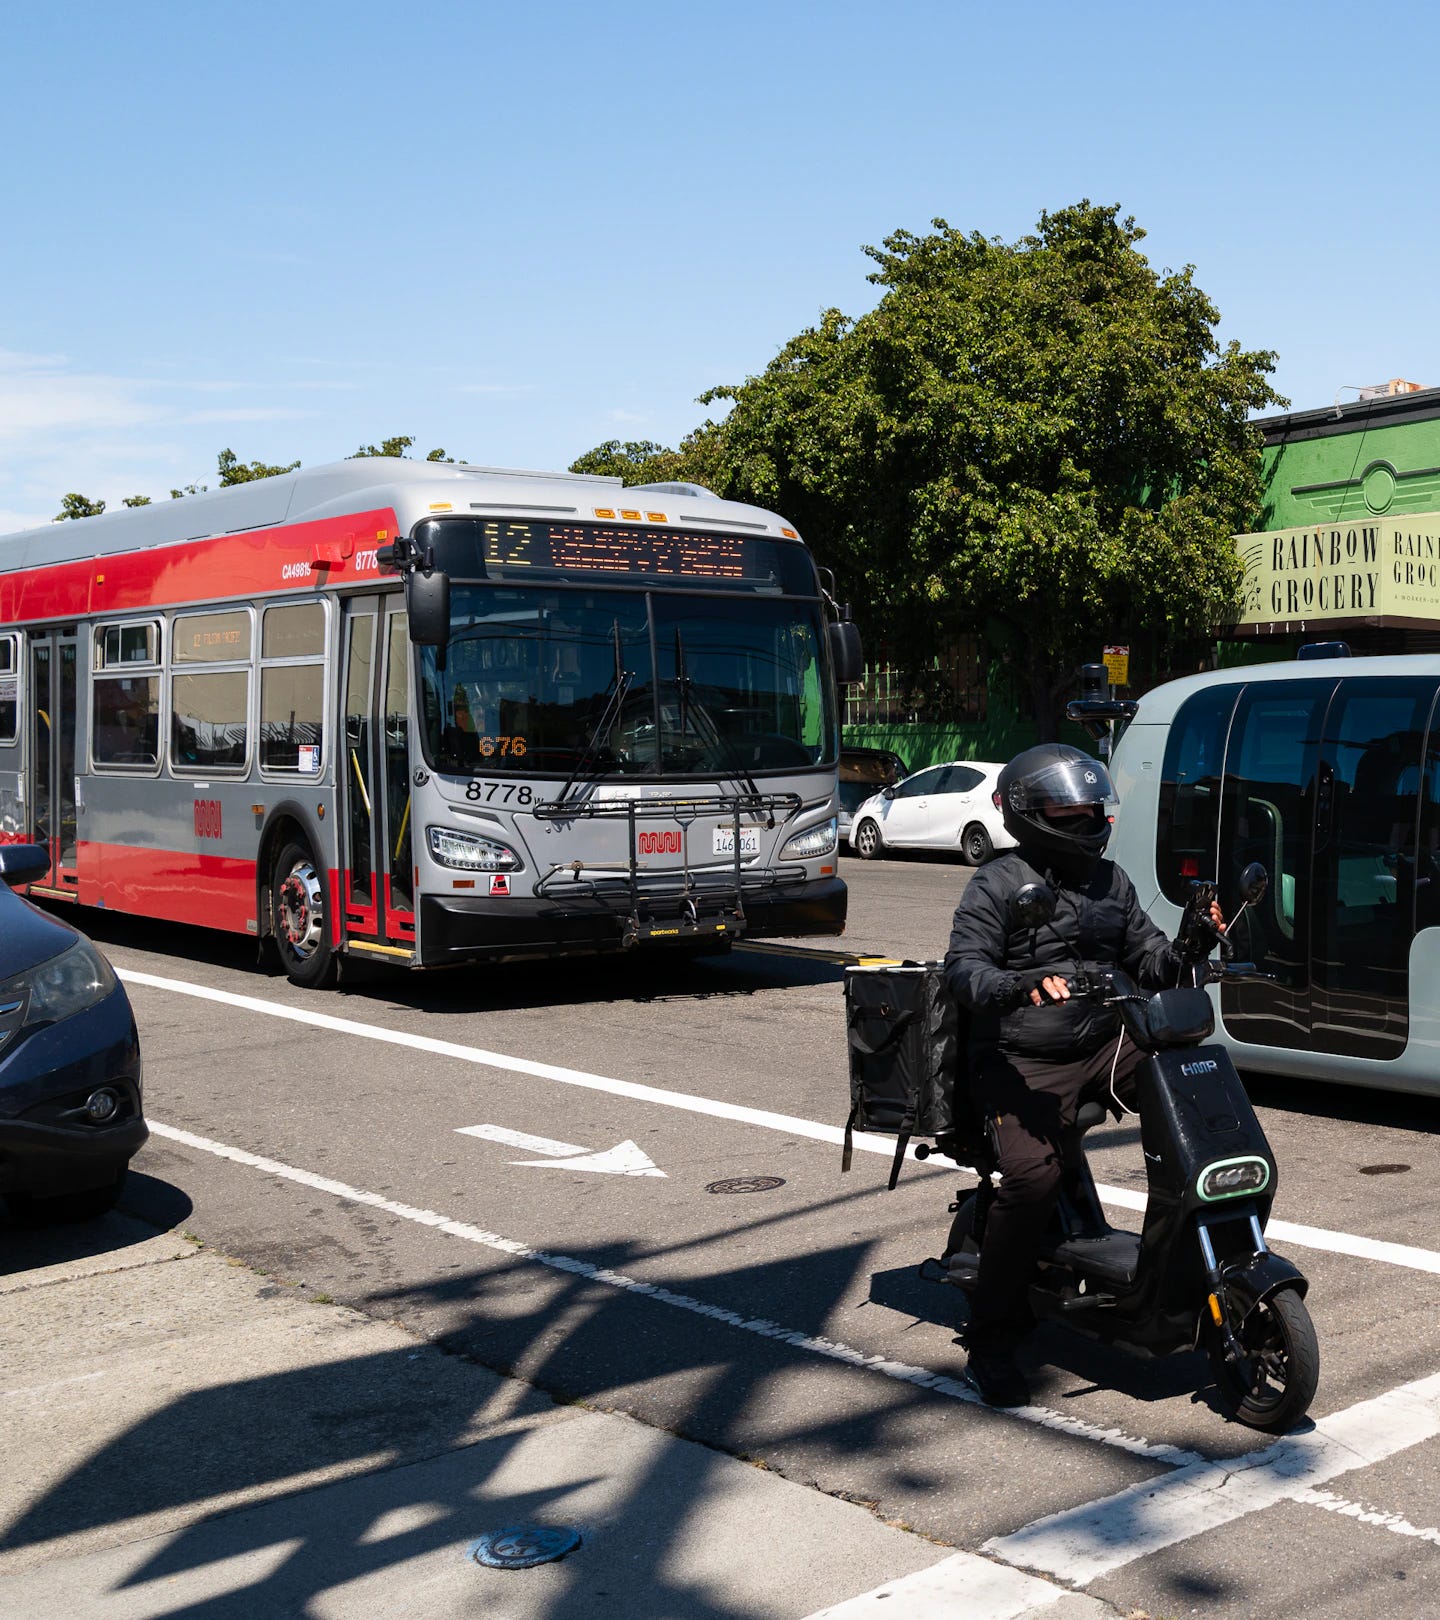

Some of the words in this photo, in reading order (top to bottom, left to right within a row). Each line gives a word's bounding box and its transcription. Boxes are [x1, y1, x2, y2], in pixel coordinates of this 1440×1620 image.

[484, 523, 532, 565] 12
[1272, 527, 1381, 571] RAINBOW
[355, 550, 378, 571] 8778
[1271, 572, 1379, 615] GROCERY
[1394, 593, 1399, 601] A
[479, 736, 528, 757] 676
[465, 781, 532, 805] 8778
[716, 837, 758, 852] 146061
